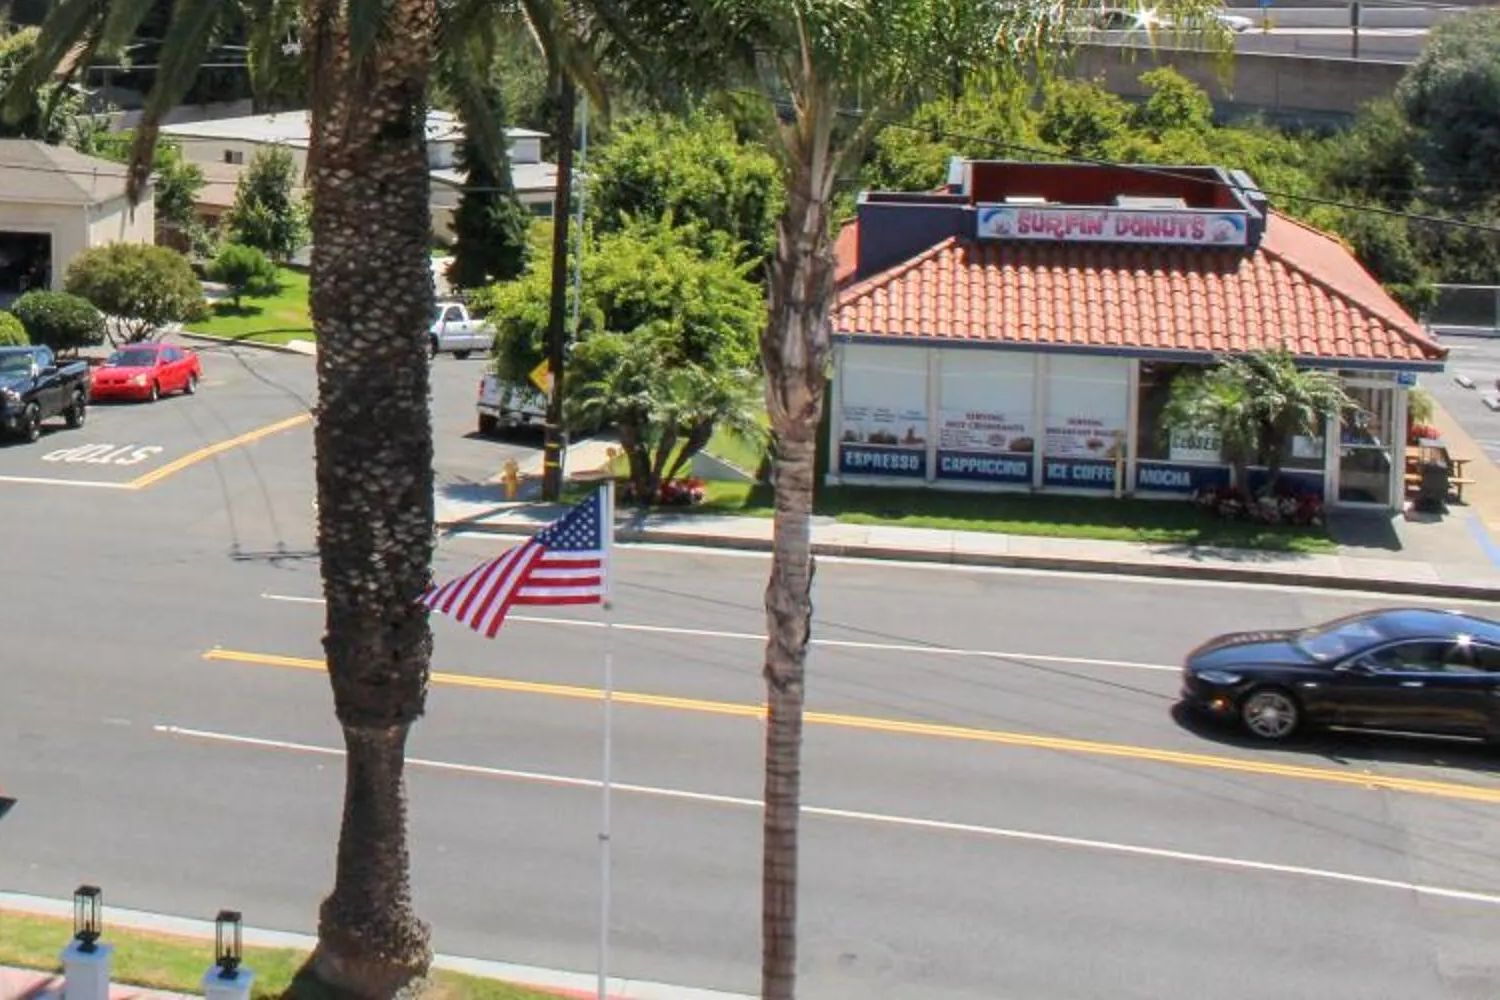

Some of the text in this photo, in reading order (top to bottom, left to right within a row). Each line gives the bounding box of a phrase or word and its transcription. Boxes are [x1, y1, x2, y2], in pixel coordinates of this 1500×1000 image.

[1115, 214, 1205, 239] DONUTS
[41, 443, 164, 465] STOP
[941, 456, 1028, 476] CAPPUCCINO
[1047, 462, 1067, 479] ICE
[1139, 469, 1191, 487] MOCHA
